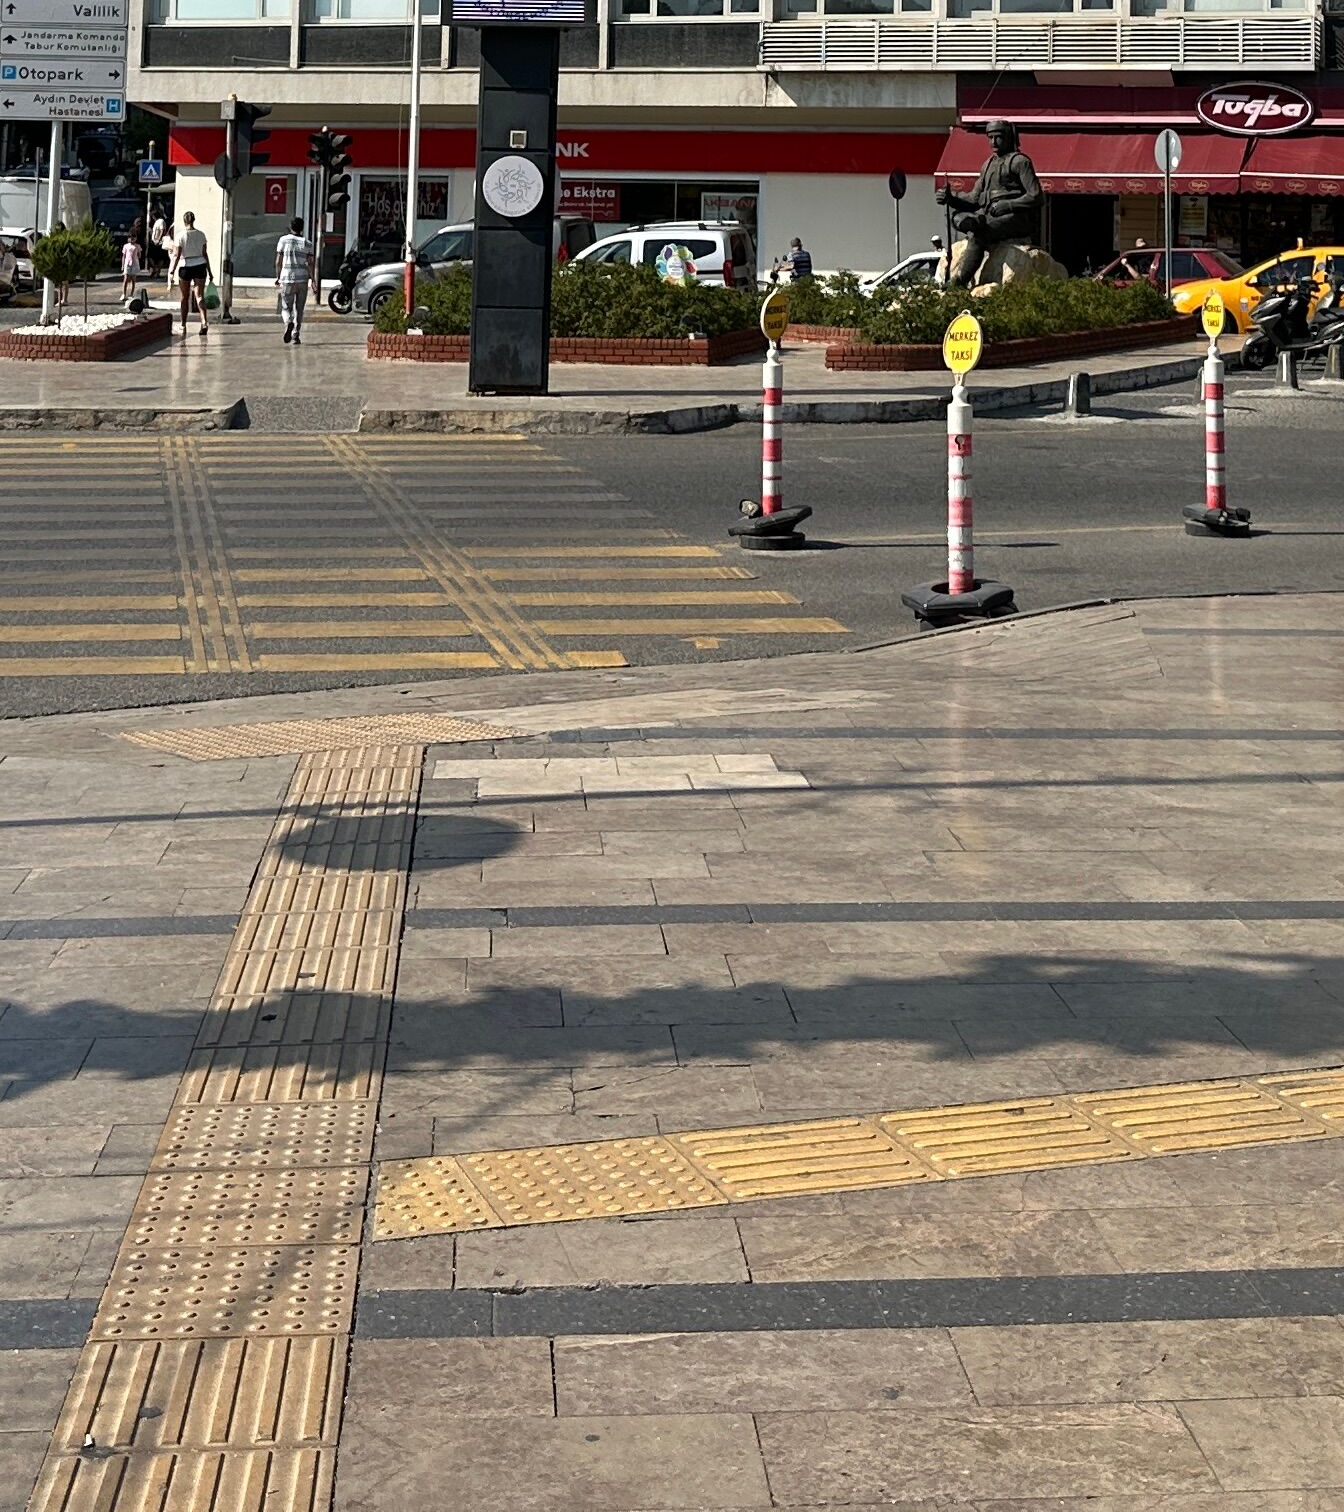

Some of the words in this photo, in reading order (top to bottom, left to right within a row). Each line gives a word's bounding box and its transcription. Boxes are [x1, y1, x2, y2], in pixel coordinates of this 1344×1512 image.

[73, 4, 120, 17] Valilik
[21, 31, 73, 40] Jandarma
[76, 32, 125, 41] Komando
[24, 41, 54, 50] Tabur
[57, 43, 121, 54] Komutanlığı
[18, 66, 84, 83] Otopark
[33, 94, 66, 105] Aydın
[69, 94, 104, 105] Devlet
[49, 107, 104, 117] Hastanesi
[574, 186, 615, 198] Ekstra
[949, 332, 978, 341] MERKEZ
[951, 348, 972, 360] TAKSİ
